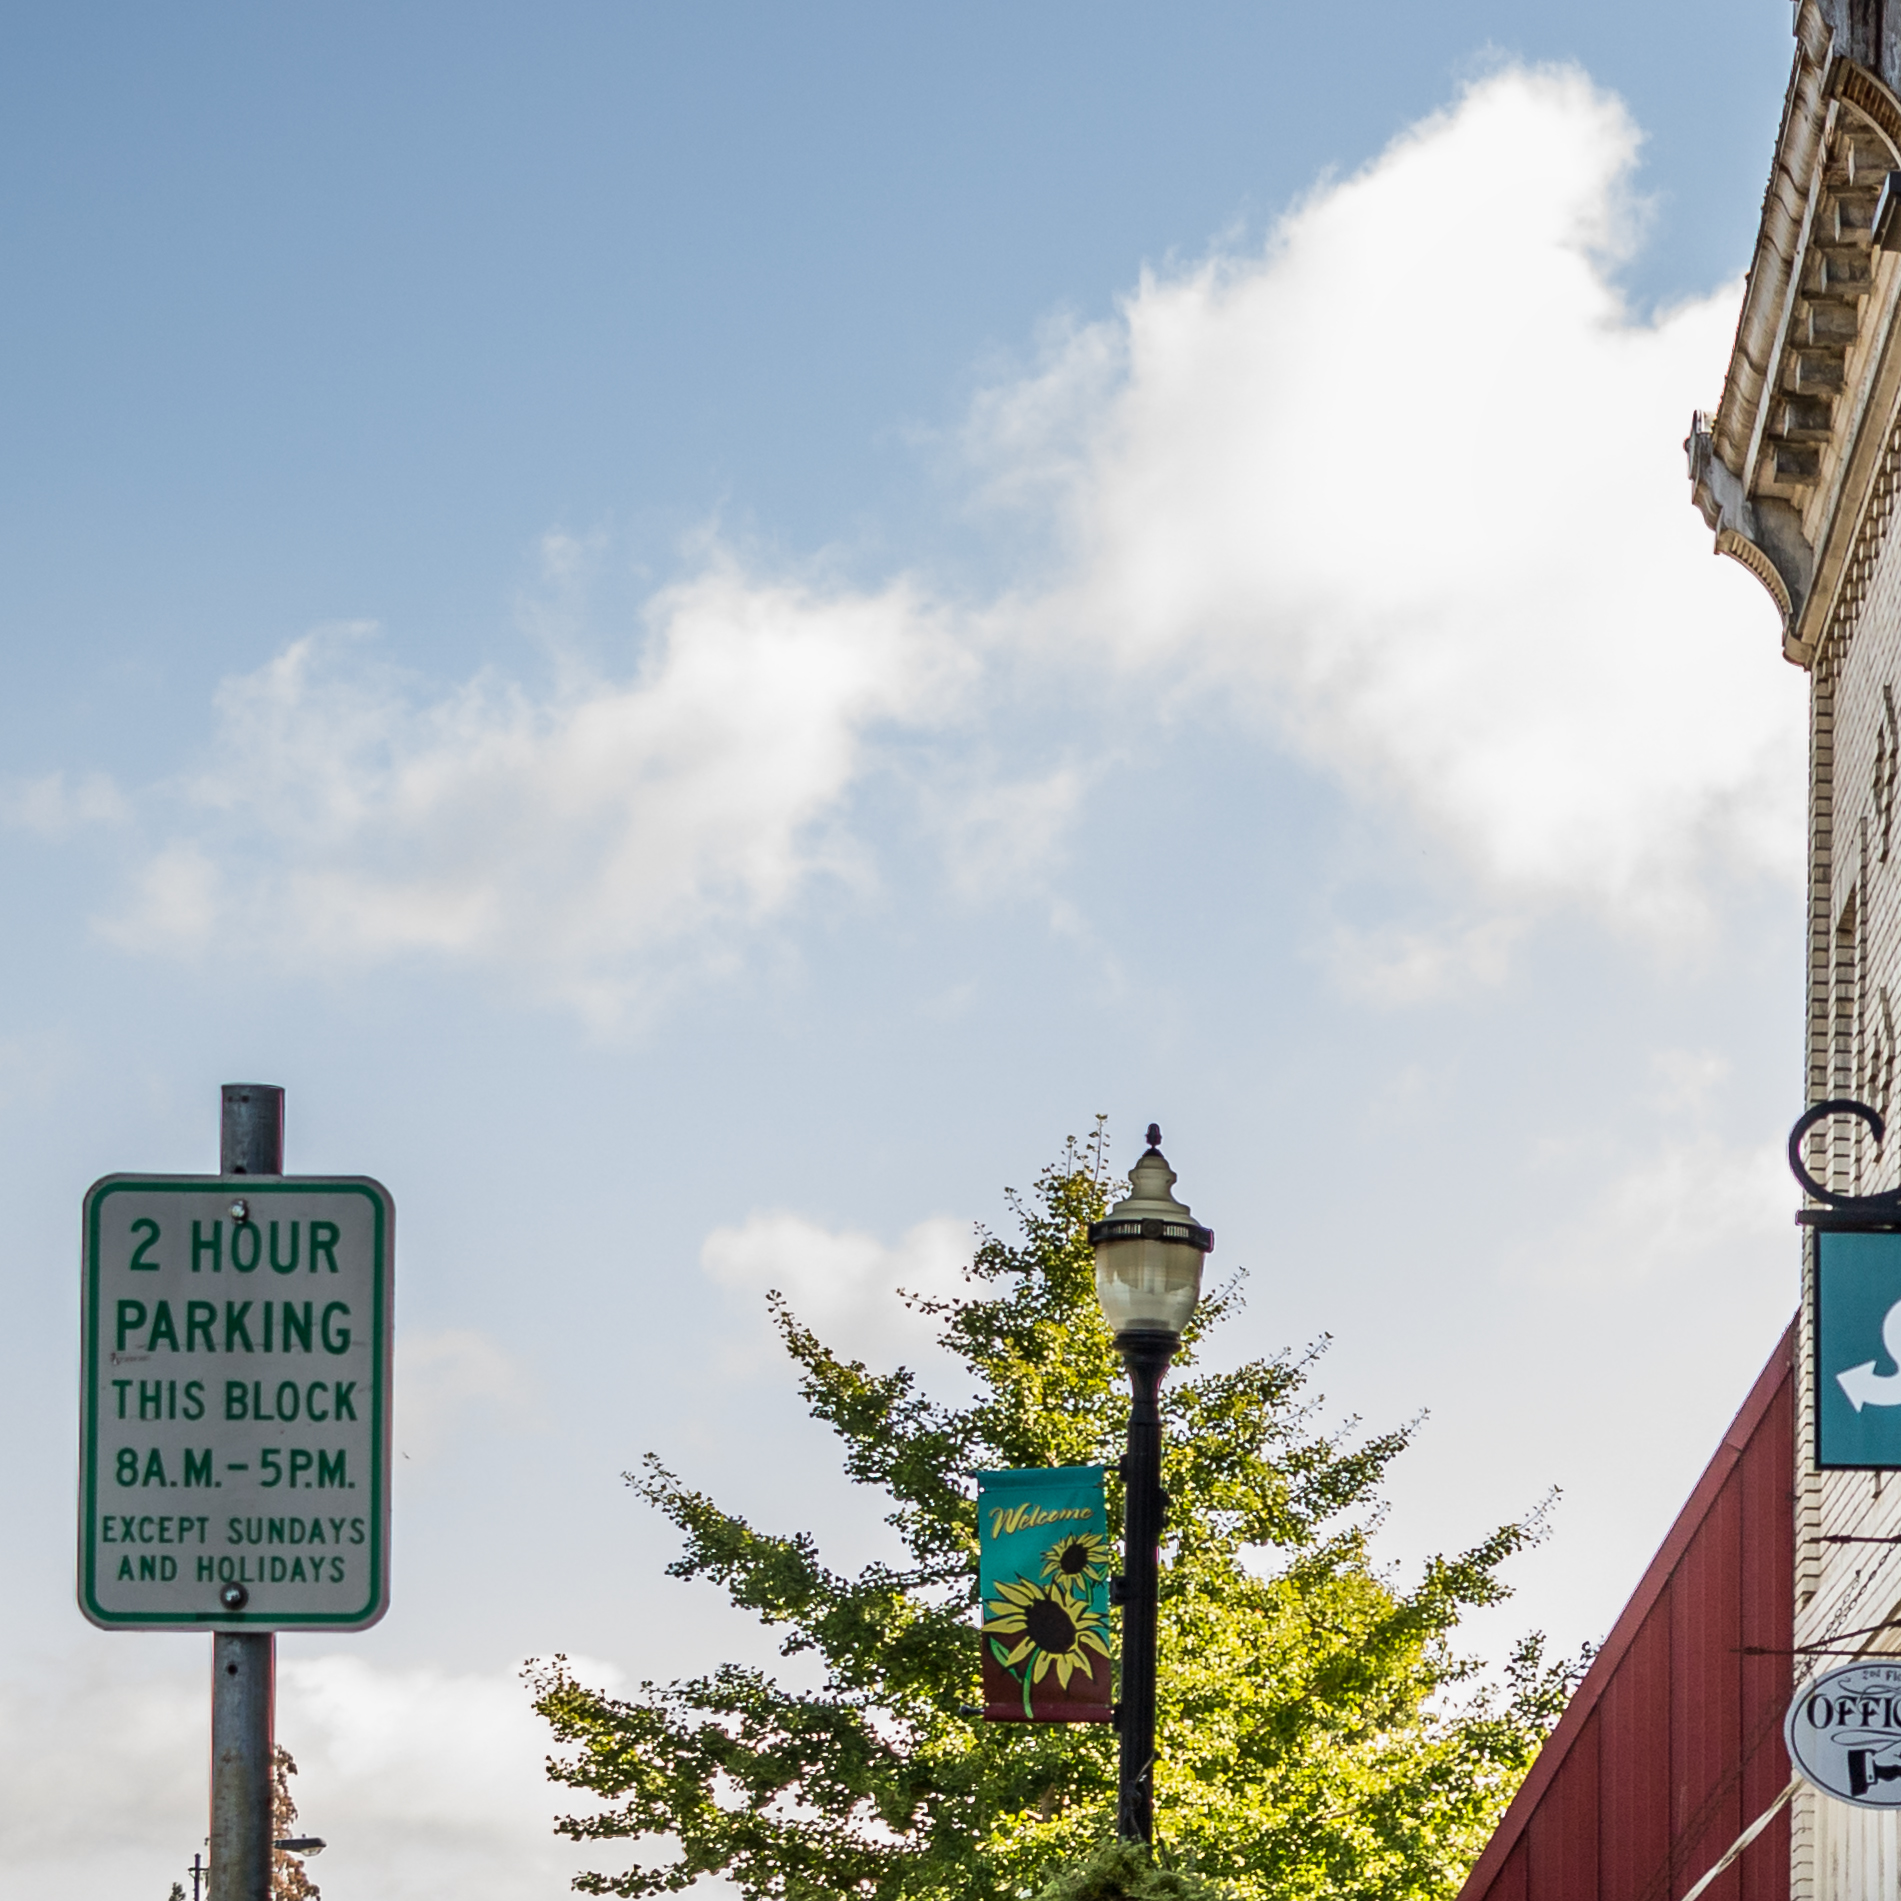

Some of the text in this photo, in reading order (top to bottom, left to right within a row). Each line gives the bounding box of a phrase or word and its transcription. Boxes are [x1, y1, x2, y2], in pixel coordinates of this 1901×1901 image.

[129, 1218, 341, 1274] 2 HOUR
[116, 1299, 352, 1355] PARKING
[111, 1379, 358, 1422] THIS BLOCK
[102, 1515, 365, 1545] EXCEPT SUNDAYS
[988, 1502, 1094, 1540] Welcome
[117, 1556, 345, 1584] AND HOLIDAYS
[1862, 1669, 1881, 1681] 2nd
